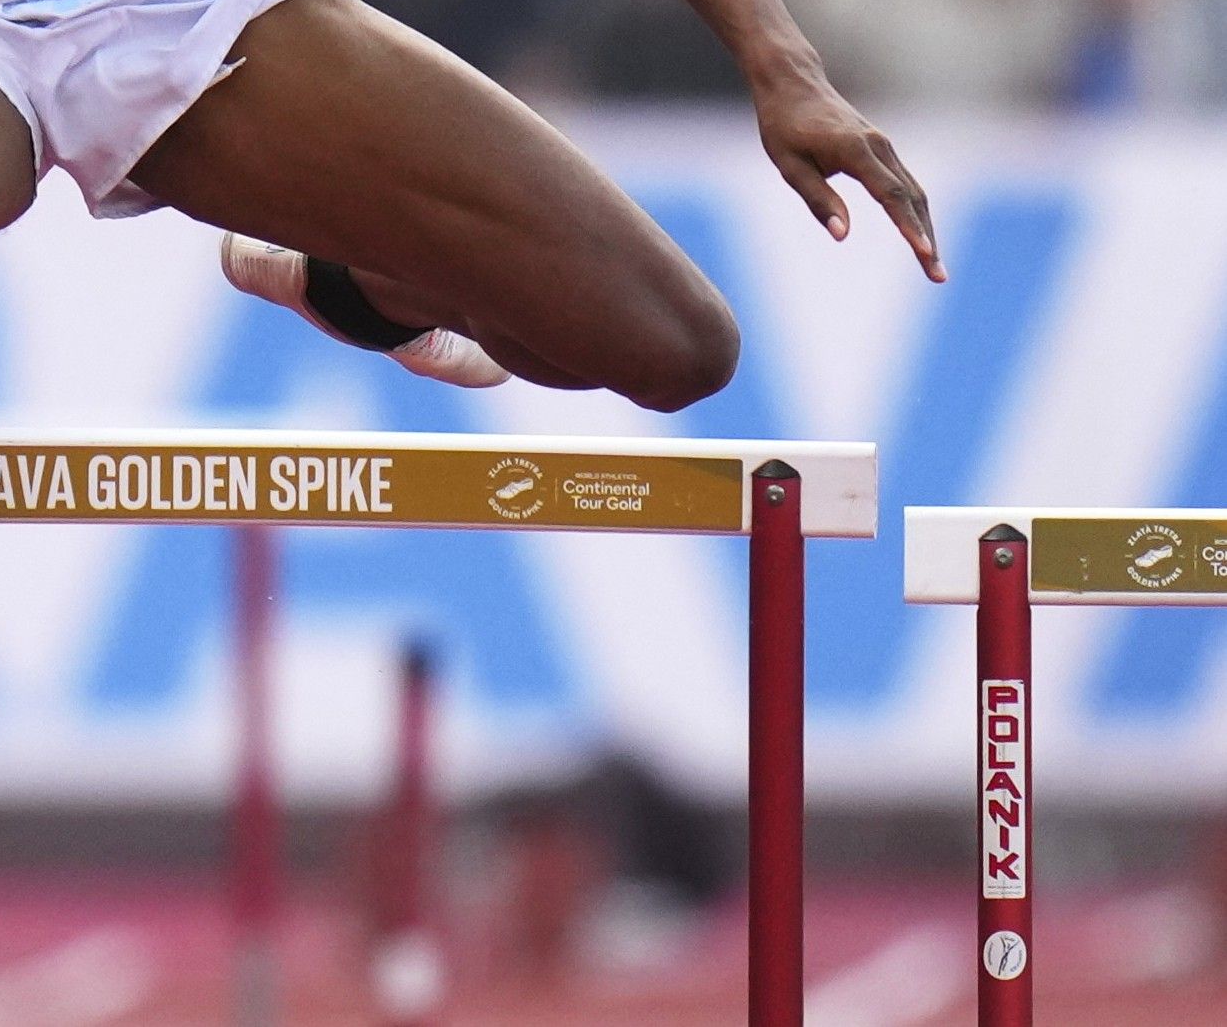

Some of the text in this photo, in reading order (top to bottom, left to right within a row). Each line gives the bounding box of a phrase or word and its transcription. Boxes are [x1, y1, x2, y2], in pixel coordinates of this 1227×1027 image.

[87, 454, 256, 512] GOLDEN
[269, 455, 394, 514] SPIKE
[563, 480, 650, 496] Continental
[488, 497, 520, 520] GOLDEN
[571, 495, 642, 511] Tour Gold
[1202, 546, 1227, 561] Co
[1127, 566, 1159, 588] GOLDEN
[986, 685, 1022, 881] POLANIK
